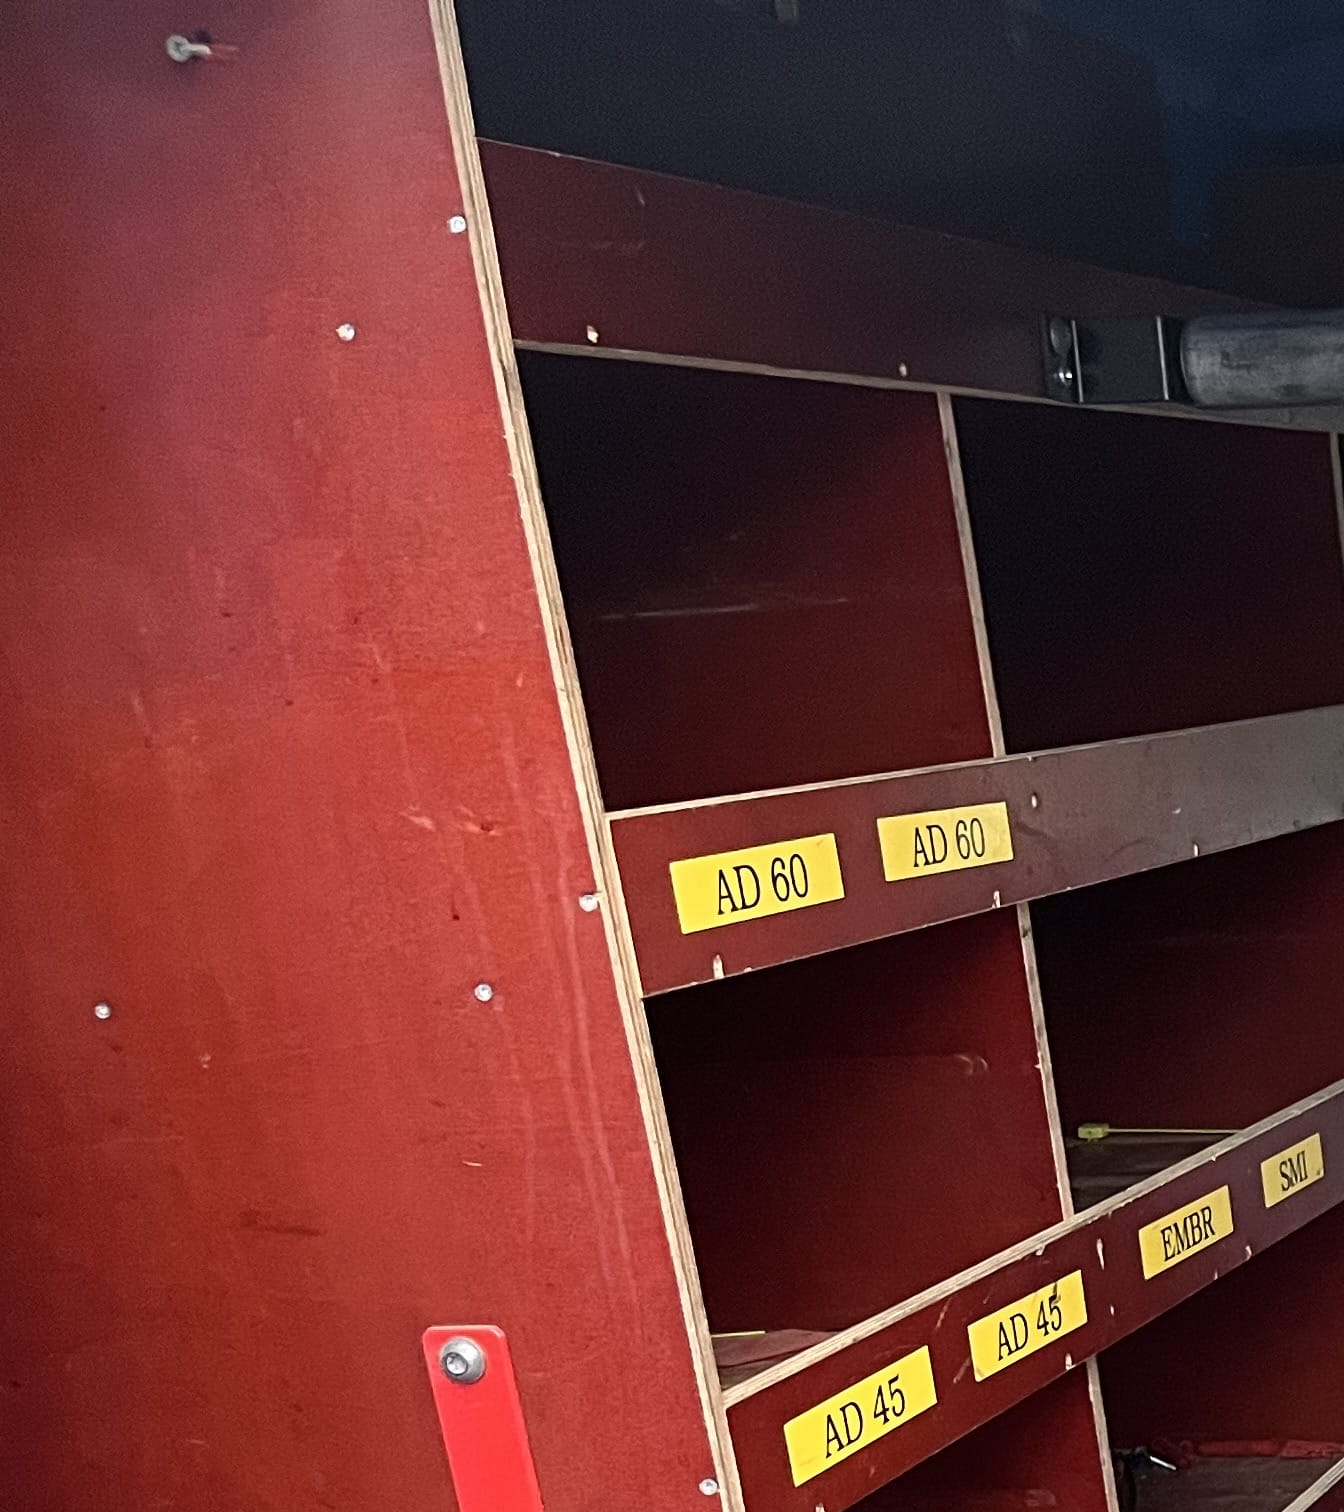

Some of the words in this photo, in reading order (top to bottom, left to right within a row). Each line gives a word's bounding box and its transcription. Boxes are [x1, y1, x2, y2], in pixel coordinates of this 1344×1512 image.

[913, 823, 948, 868] AD
[955, 817, 986, 860] 60
[717, 864, 761, 915] AD
[771, 853, 808, 902] 60
[1279, 1151, 1308, 1191] SMI
[1160, 1206, 1215, 1262] EMBR
[998, 1312, 1028, 1361] AD
[1036, 1294, 1062, 1337] 45
[825, 1400, 863, 1459] AD
[873, 1374, 905, 1425] 45
